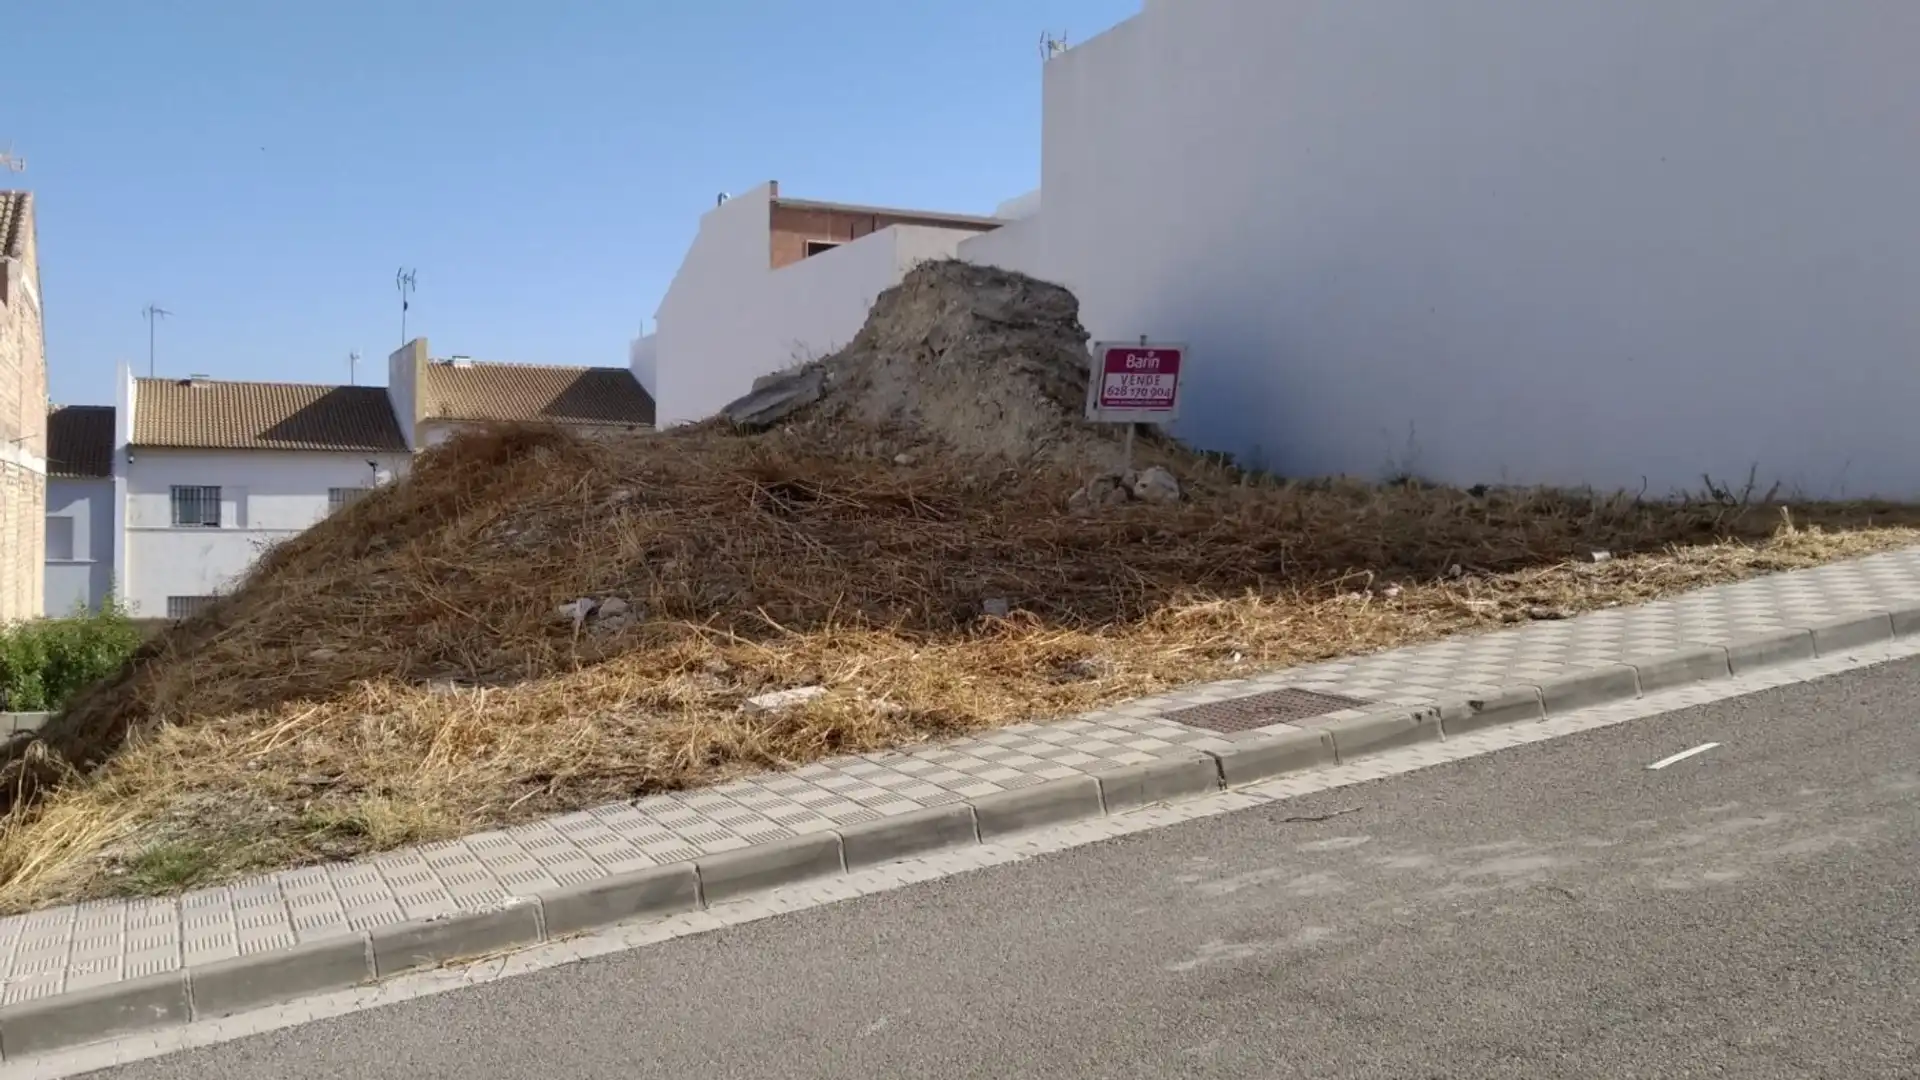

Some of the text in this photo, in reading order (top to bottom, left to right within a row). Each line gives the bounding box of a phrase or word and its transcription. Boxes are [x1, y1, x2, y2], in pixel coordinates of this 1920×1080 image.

[1120, 375, 1160, 386] VENDE
[1107, 385, 1172, 399] 628 170 904
